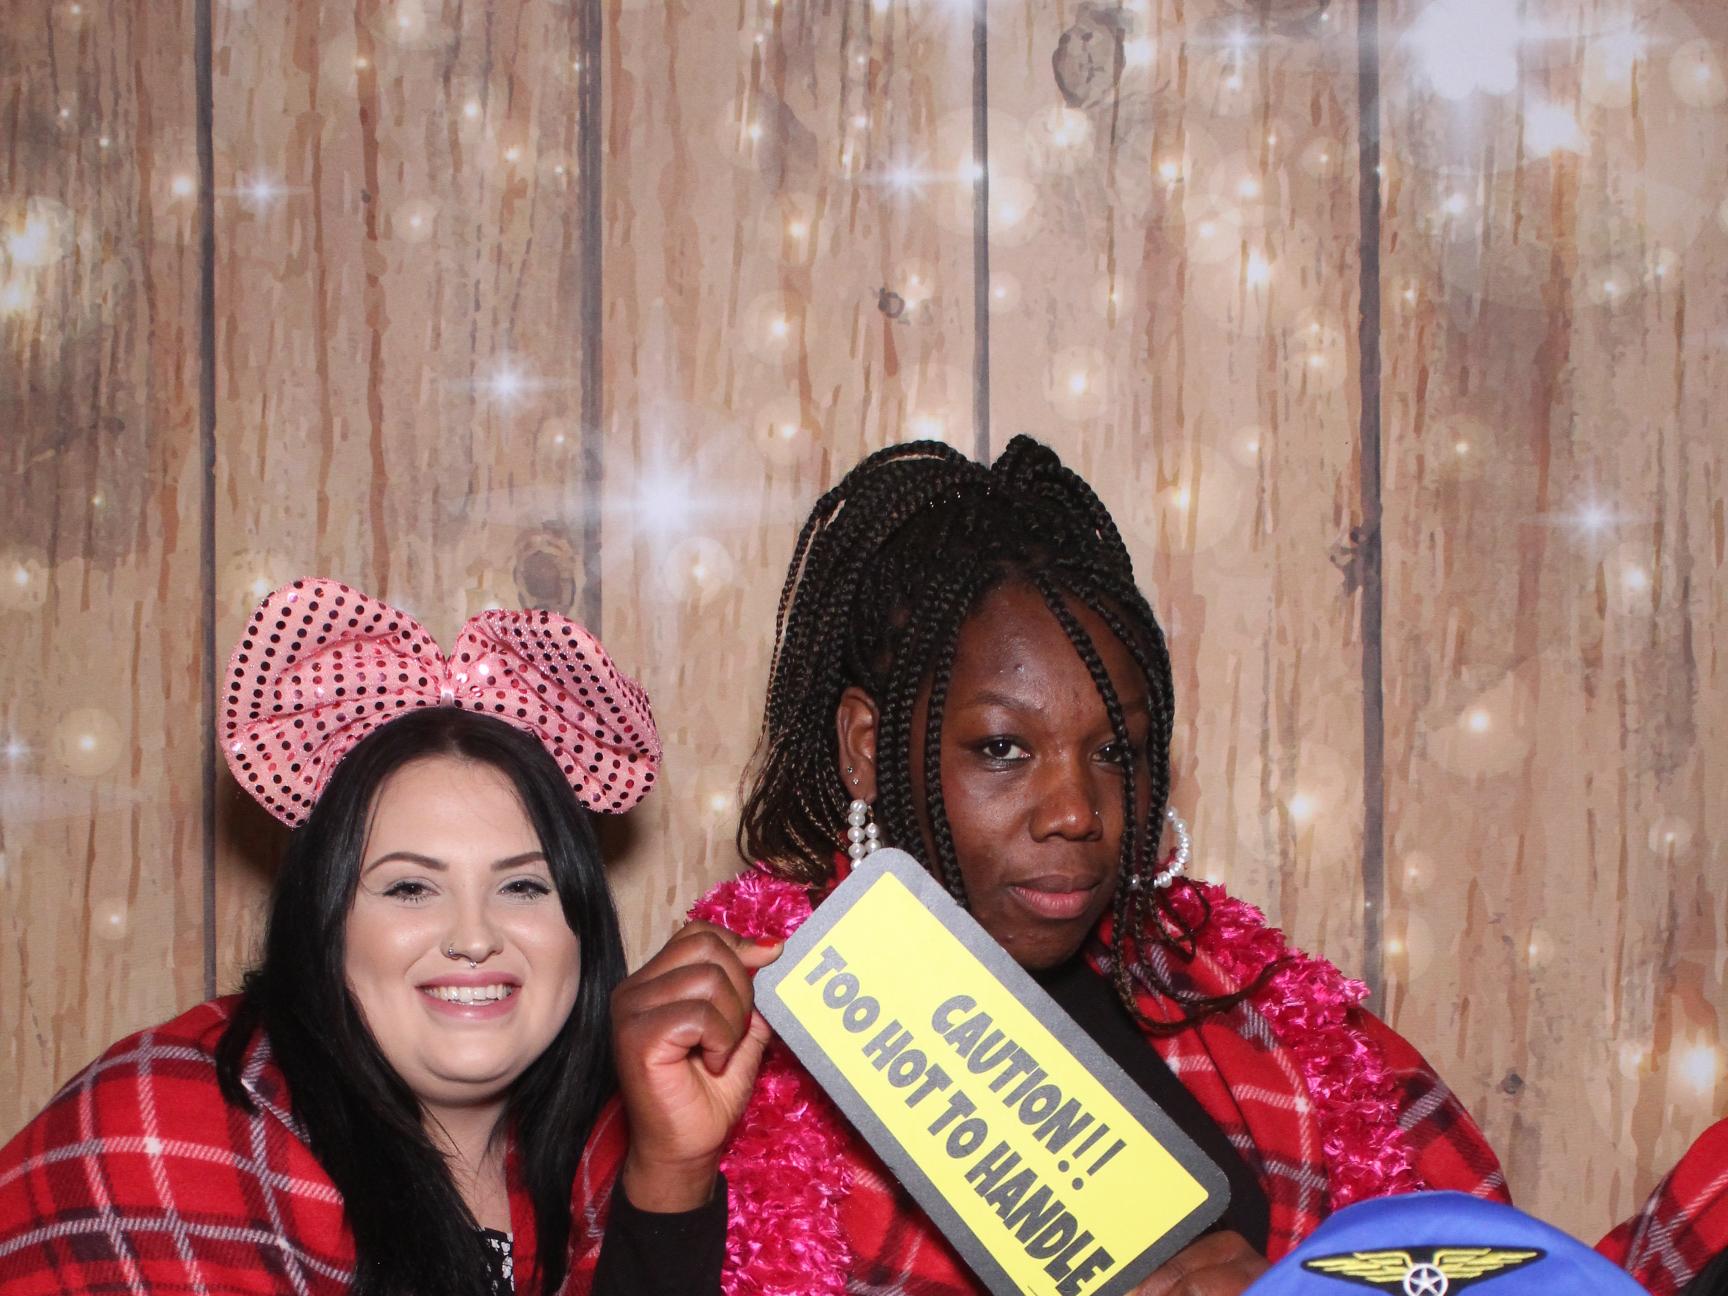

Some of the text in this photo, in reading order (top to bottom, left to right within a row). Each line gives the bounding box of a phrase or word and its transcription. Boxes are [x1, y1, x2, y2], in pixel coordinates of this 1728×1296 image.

[804, 946, 881, 1033] TOO
[862, 1020, 953, 1108] HOT
[928, 1090, 988, 1159] TO
[931, 994, 1127, 1190] CAUTION!!
